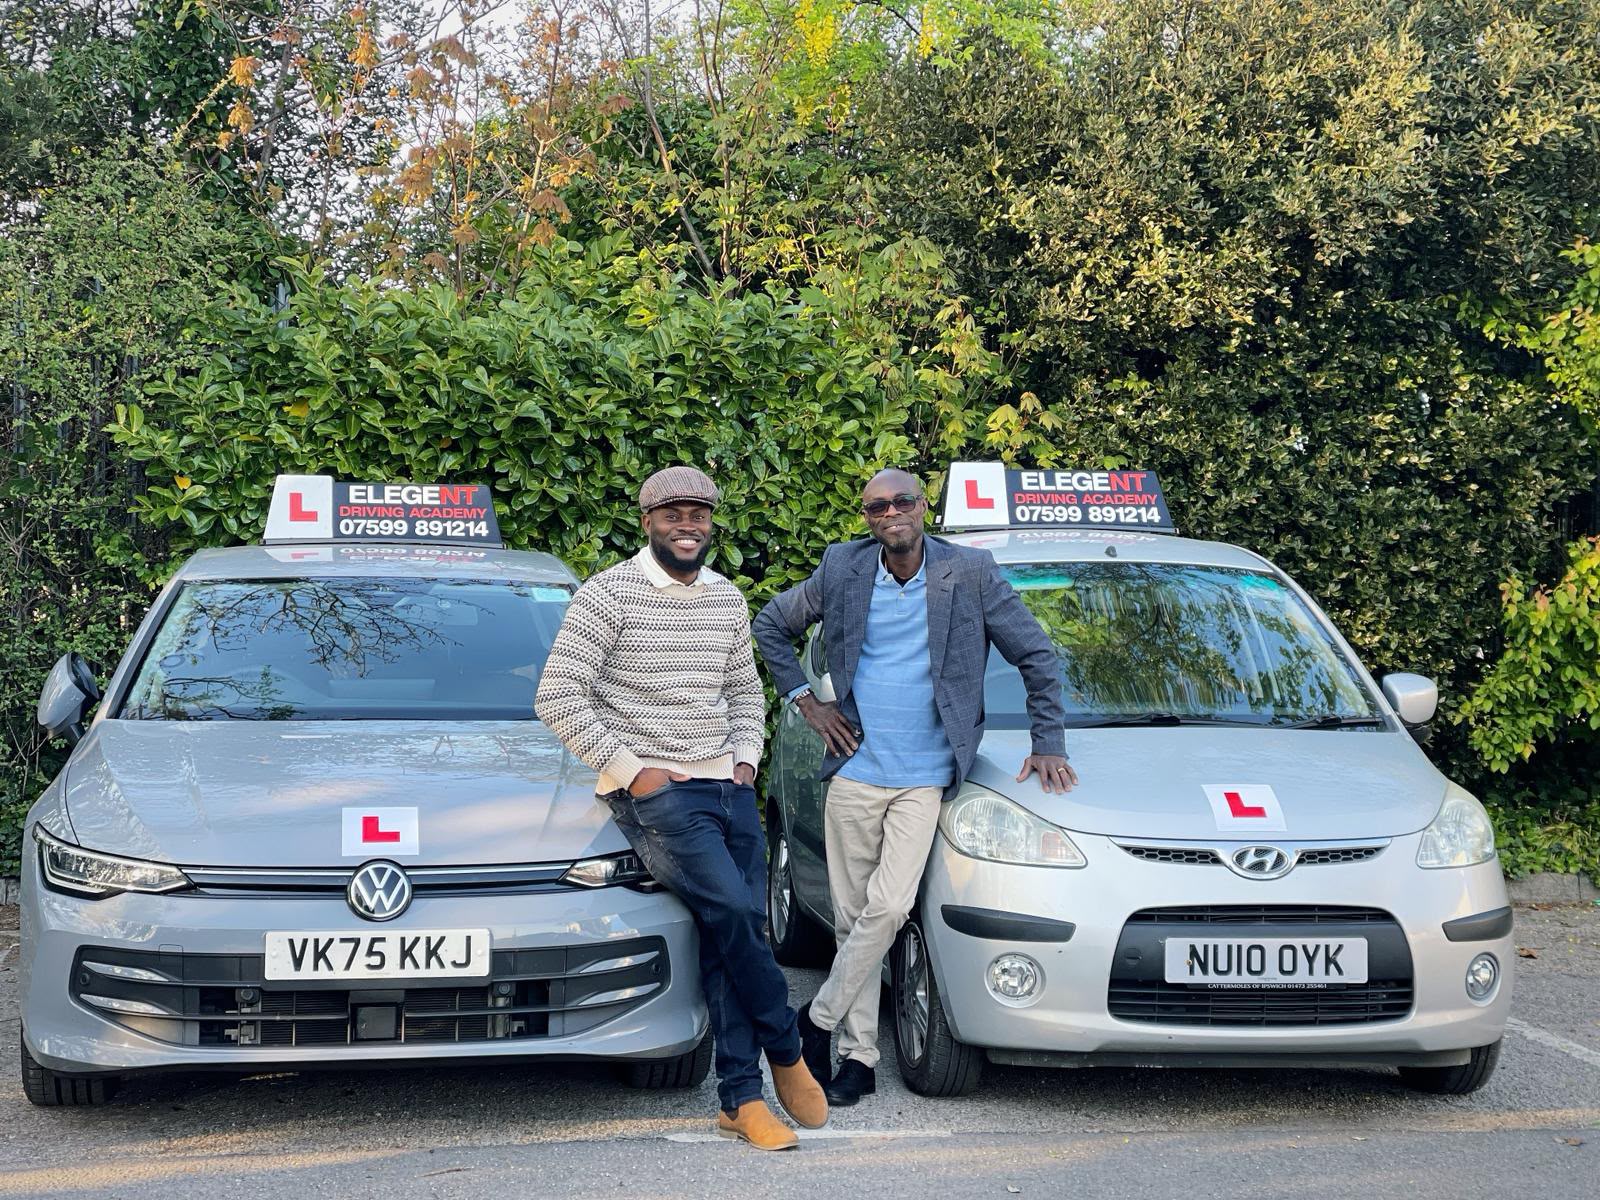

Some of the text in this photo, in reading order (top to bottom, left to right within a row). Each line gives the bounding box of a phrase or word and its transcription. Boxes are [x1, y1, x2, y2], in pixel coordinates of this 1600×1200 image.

[1020, 471, 1146, 492] ELEGENT
[349, 484, 478, 505] ELEGENT
[966, 480, 994, 509] L
[1014, 492, 1157, 506] DRIVING ACADEMY
[289, 492, 318, 522] L
[339, 505, 487, 519] DRIVING ACADEMY
[1015, 505, 1161, 523] 07599 891214
[339, 519, 489, 537] 07599 891214
[1223, 792, 1267, 818] L
[362, 816, 401, 843] L
[288, 935, 472, 972] VK75 KKJ
[1189, 943, 1344, 976] NU10 OYK
